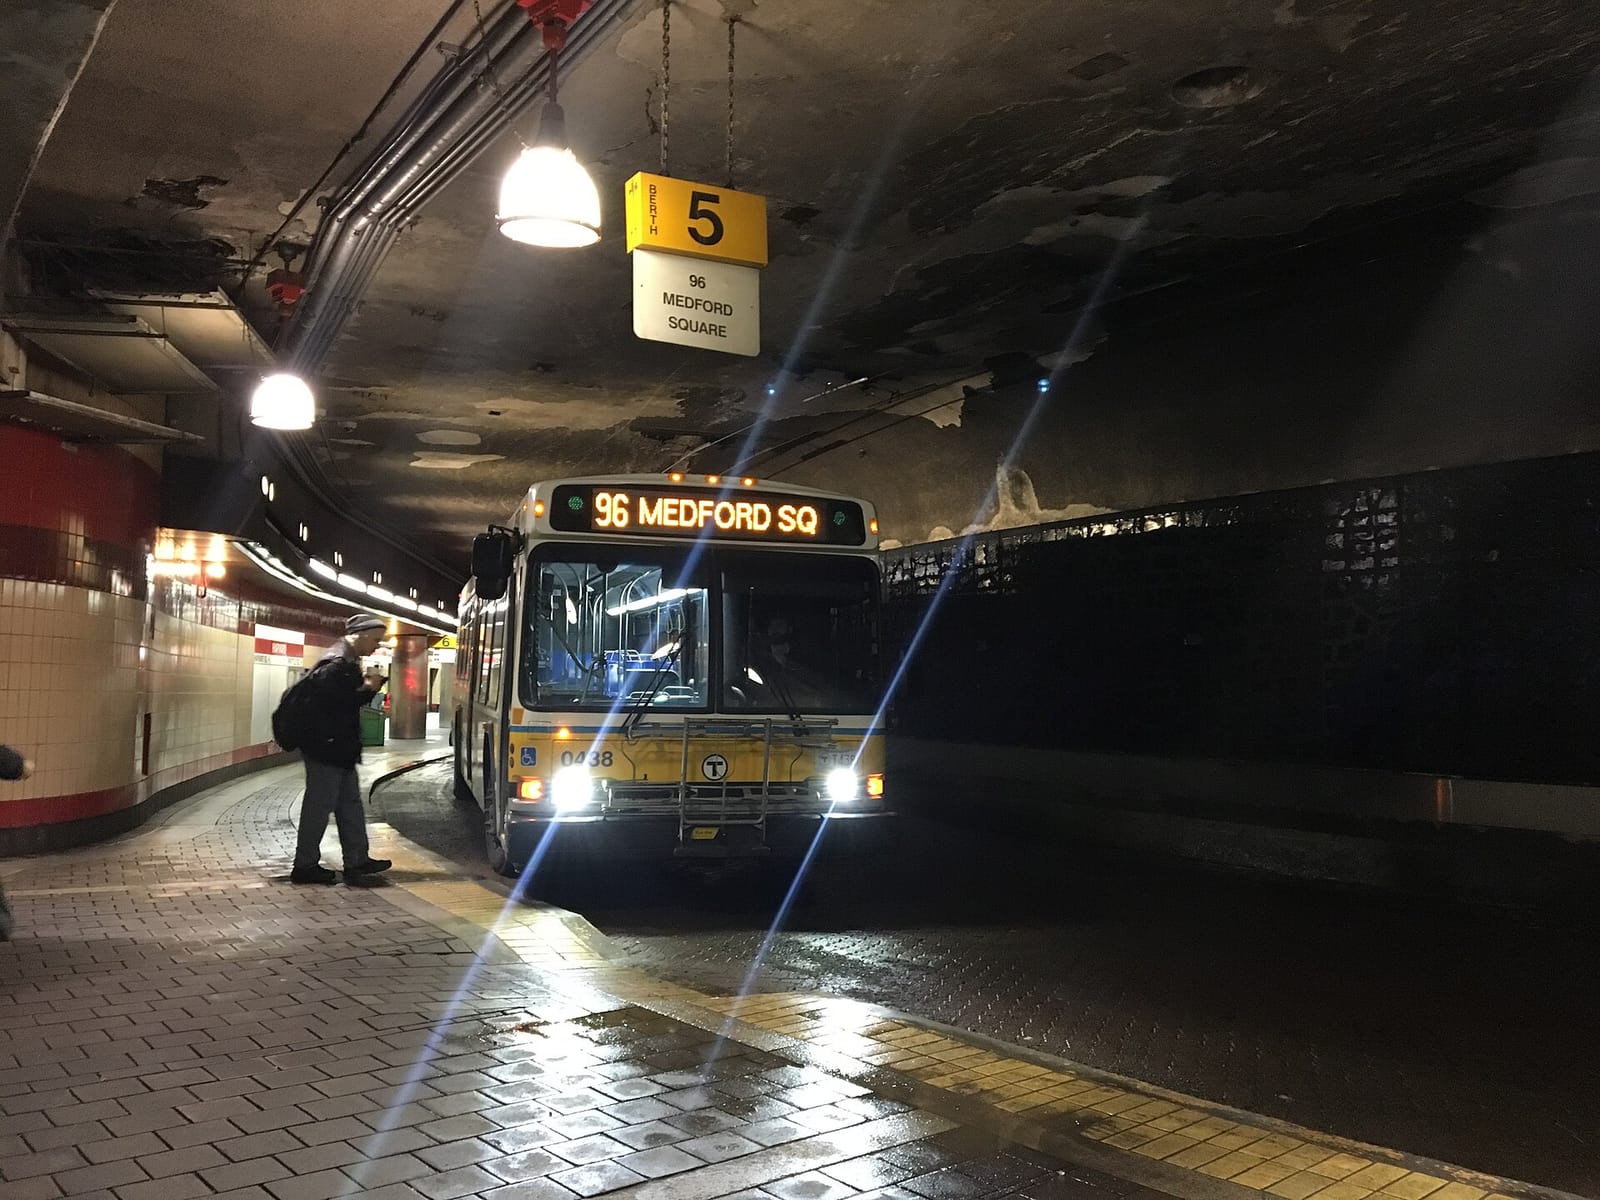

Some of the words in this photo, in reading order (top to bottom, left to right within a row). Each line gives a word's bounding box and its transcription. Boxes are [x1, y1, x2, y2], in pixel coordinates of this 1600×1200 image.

[649, 184, 658, 235] BERTH
[687, 190, 724, 246] 5
[689, 274, 706, 289] 96
[663, 291, 733, 316] MEDFORD
[668, 316, 728, 338] SQUARE
[594, 492, 629, 528] 96
[638, 497, 771, 531] MEDFORD
[777, 505, 818, 535] SQ
[442, 637, 450, 647] 6
[560, 750, 614, 767] 0438
